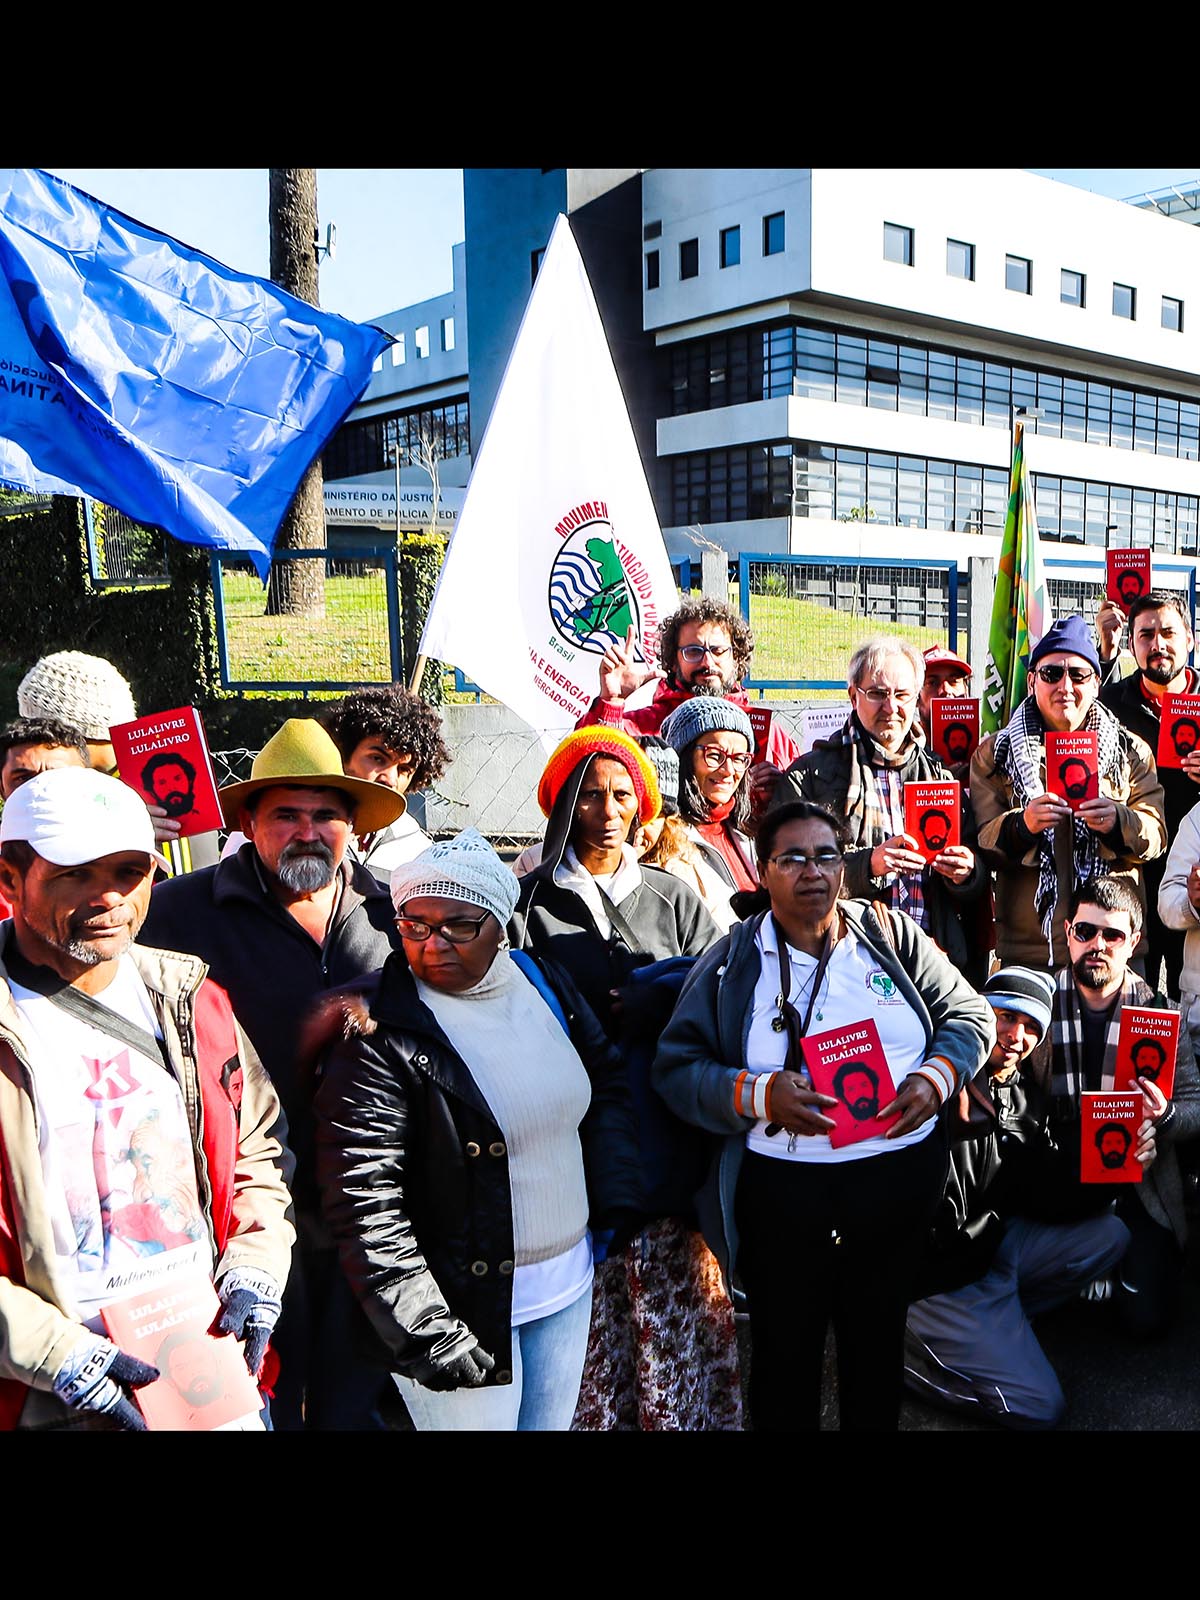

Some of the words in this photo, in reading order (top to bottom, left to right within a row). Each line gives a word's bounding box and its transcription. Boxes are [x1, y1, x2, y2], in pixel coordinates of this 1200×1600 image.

[382, 493, 395, 501] DA
[325, 508, 366, 516] AMENTO
[370, 508, 383, 517] DE
[548, 636, 575, 663] Brasil
[544, 664, 591, 706] ENERGIA
[127, 718, 185, 740] LULALIVRE
[130, 732, 189, 755] LULALIVRO
[1133, 1016, 1171, 1025] LULALIVRE
[818, 1030, 867, 1050] LULALIVRE
[1130, 1027, 1171, 1036] LULALIVRO
[821, 1043, 872, 1065] LULALIVRO
